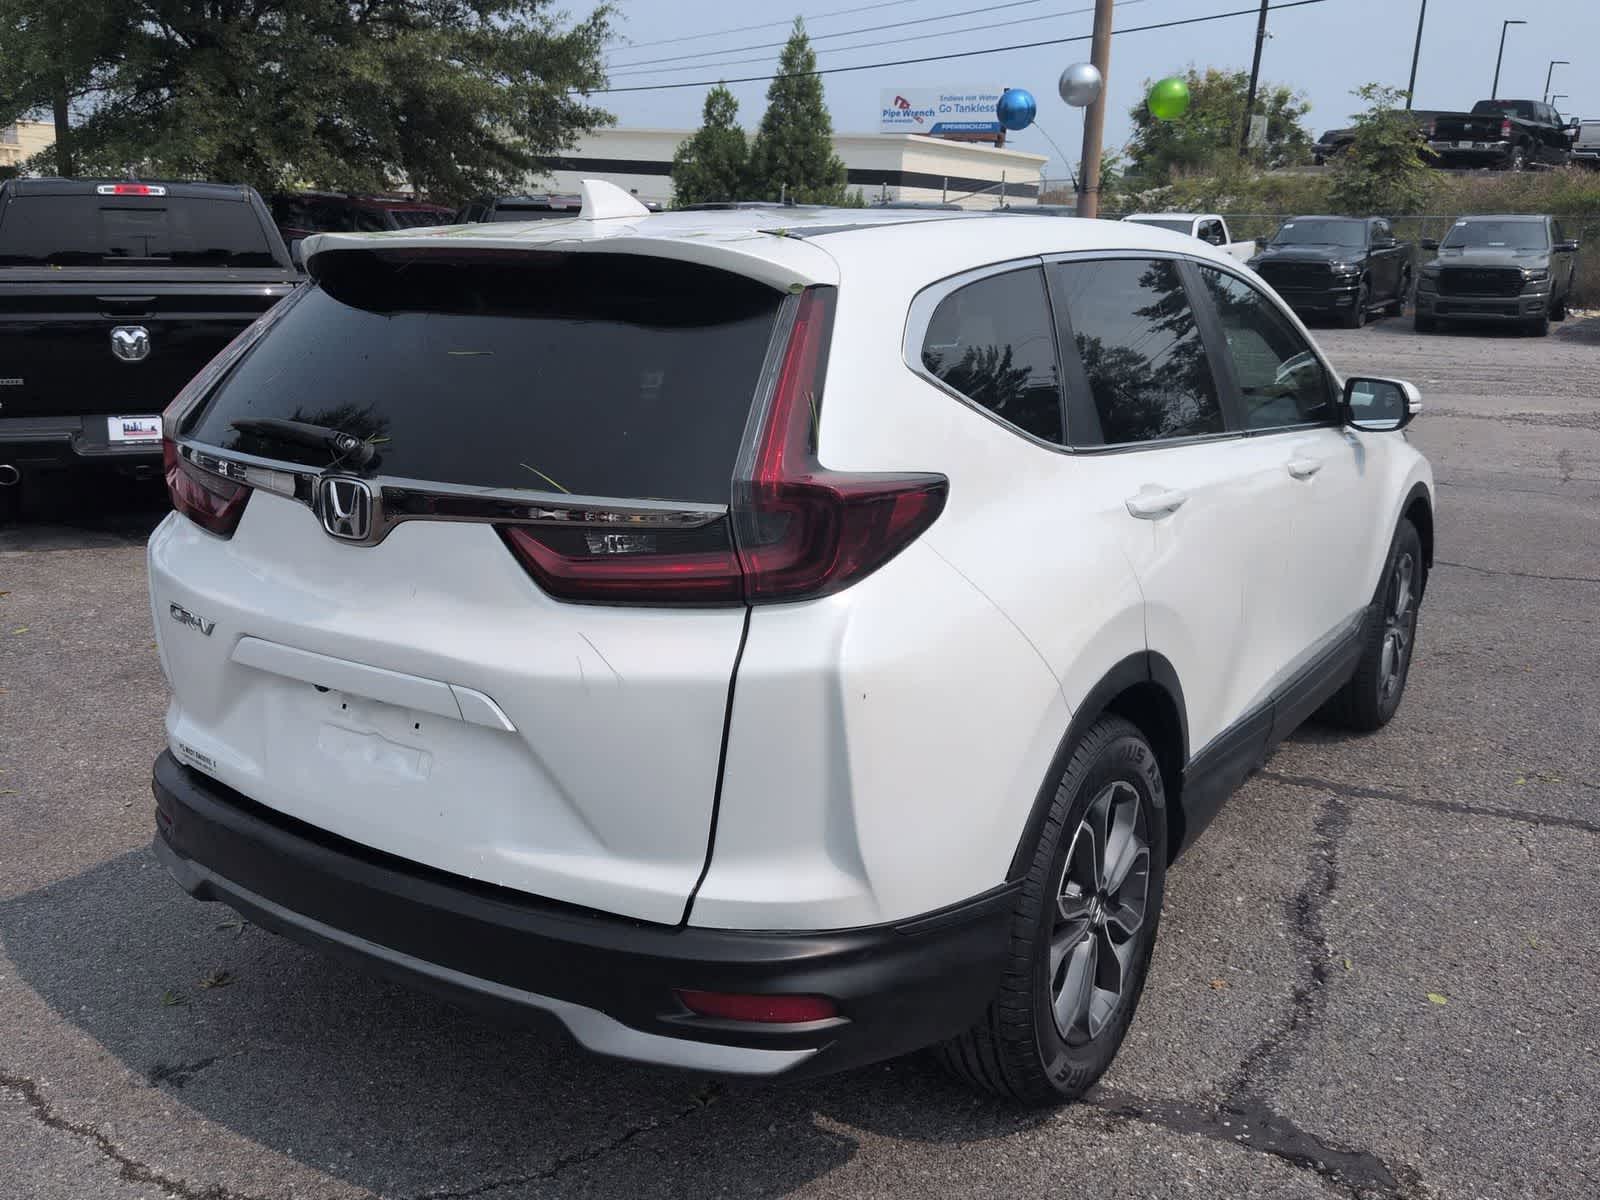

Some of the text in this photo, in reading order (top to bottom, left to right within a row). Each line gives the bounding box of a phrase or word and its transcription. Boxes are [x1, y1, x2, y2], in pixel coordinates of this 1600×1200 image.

[939, 105, 952, 113] Go
[882, 109, 935, 118] Pipe Wrench
